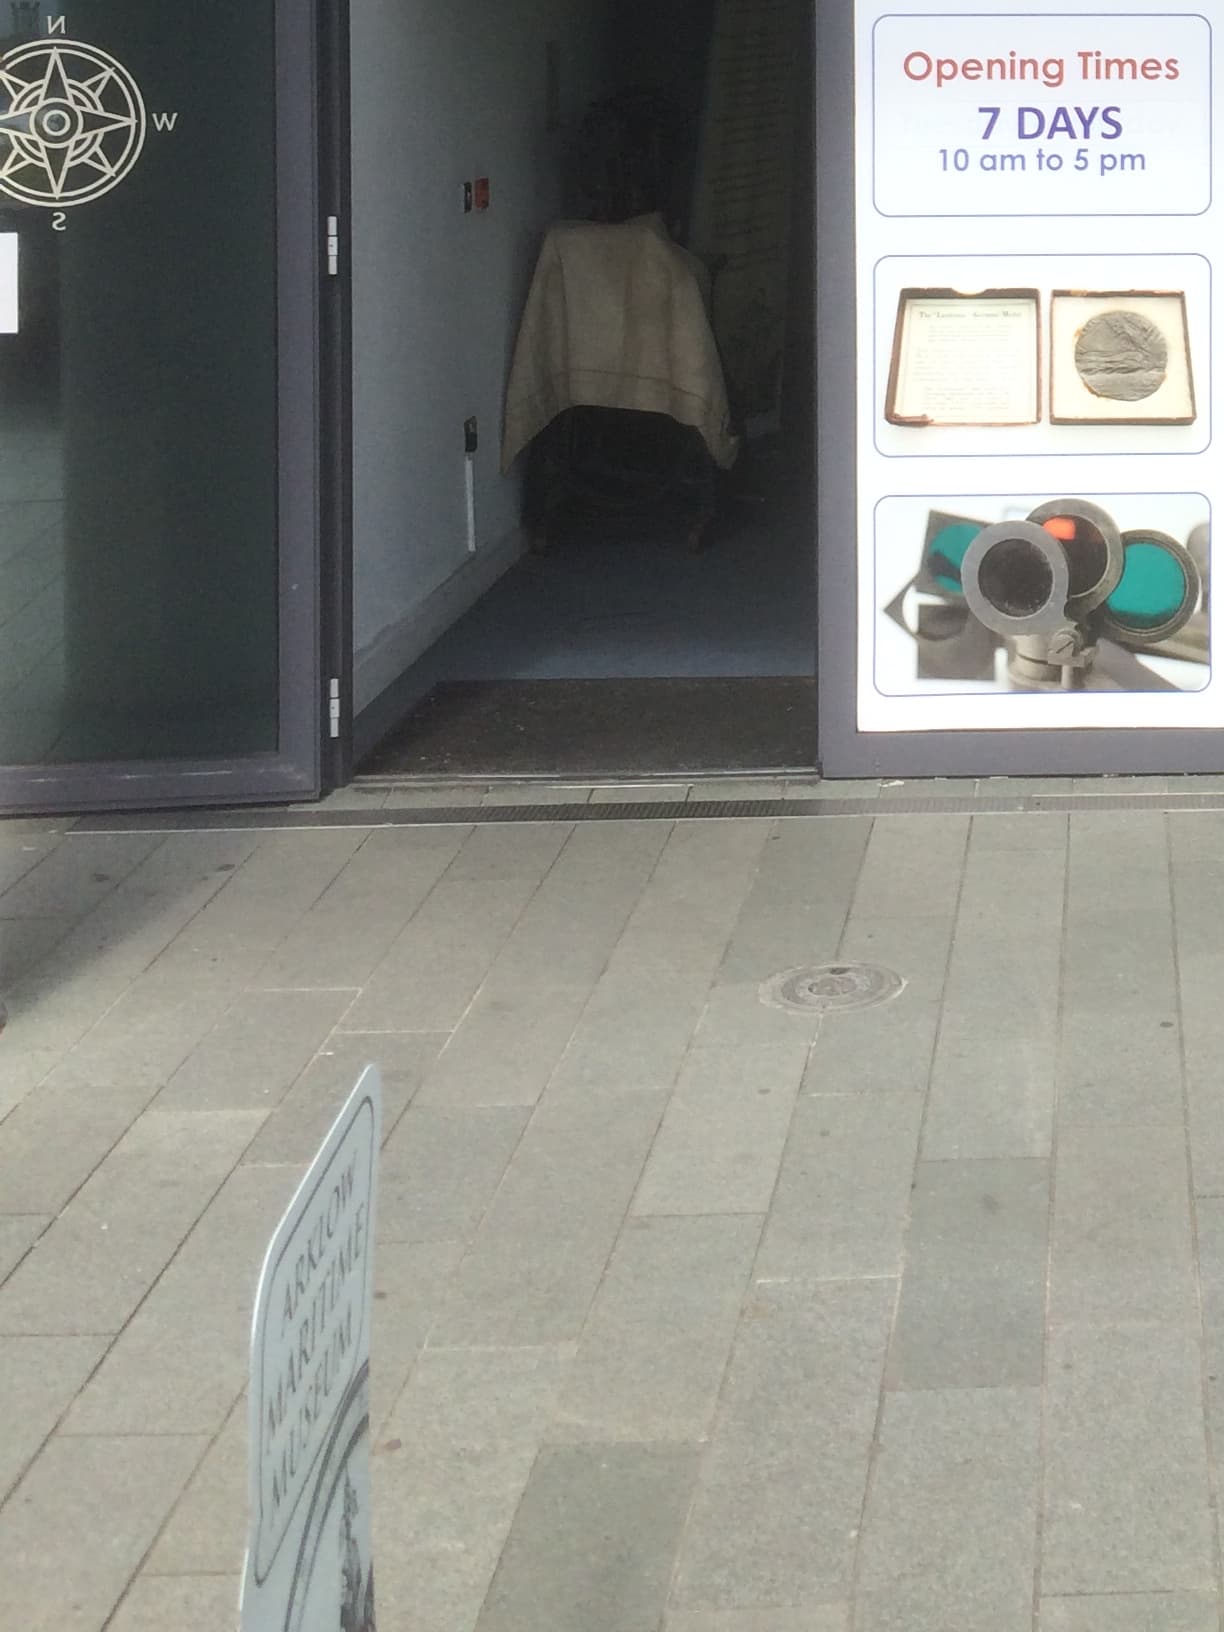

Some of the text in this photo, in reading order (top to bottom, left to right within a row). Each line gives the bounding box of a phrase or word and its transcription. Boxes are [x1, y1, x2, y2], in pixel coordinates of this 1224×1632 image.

[903, 49, 1180, 89] Opening Times
[978, 105, 1123, 141] 7 DAYS
[938, 147, 1146, 177] 10 am to 5 pm
[281, 1148, 357, 1339] ARKLOW
[266, 1202, 365, 1455] MARITIME
[270, 1302, 353, 1528] MUSEUM
